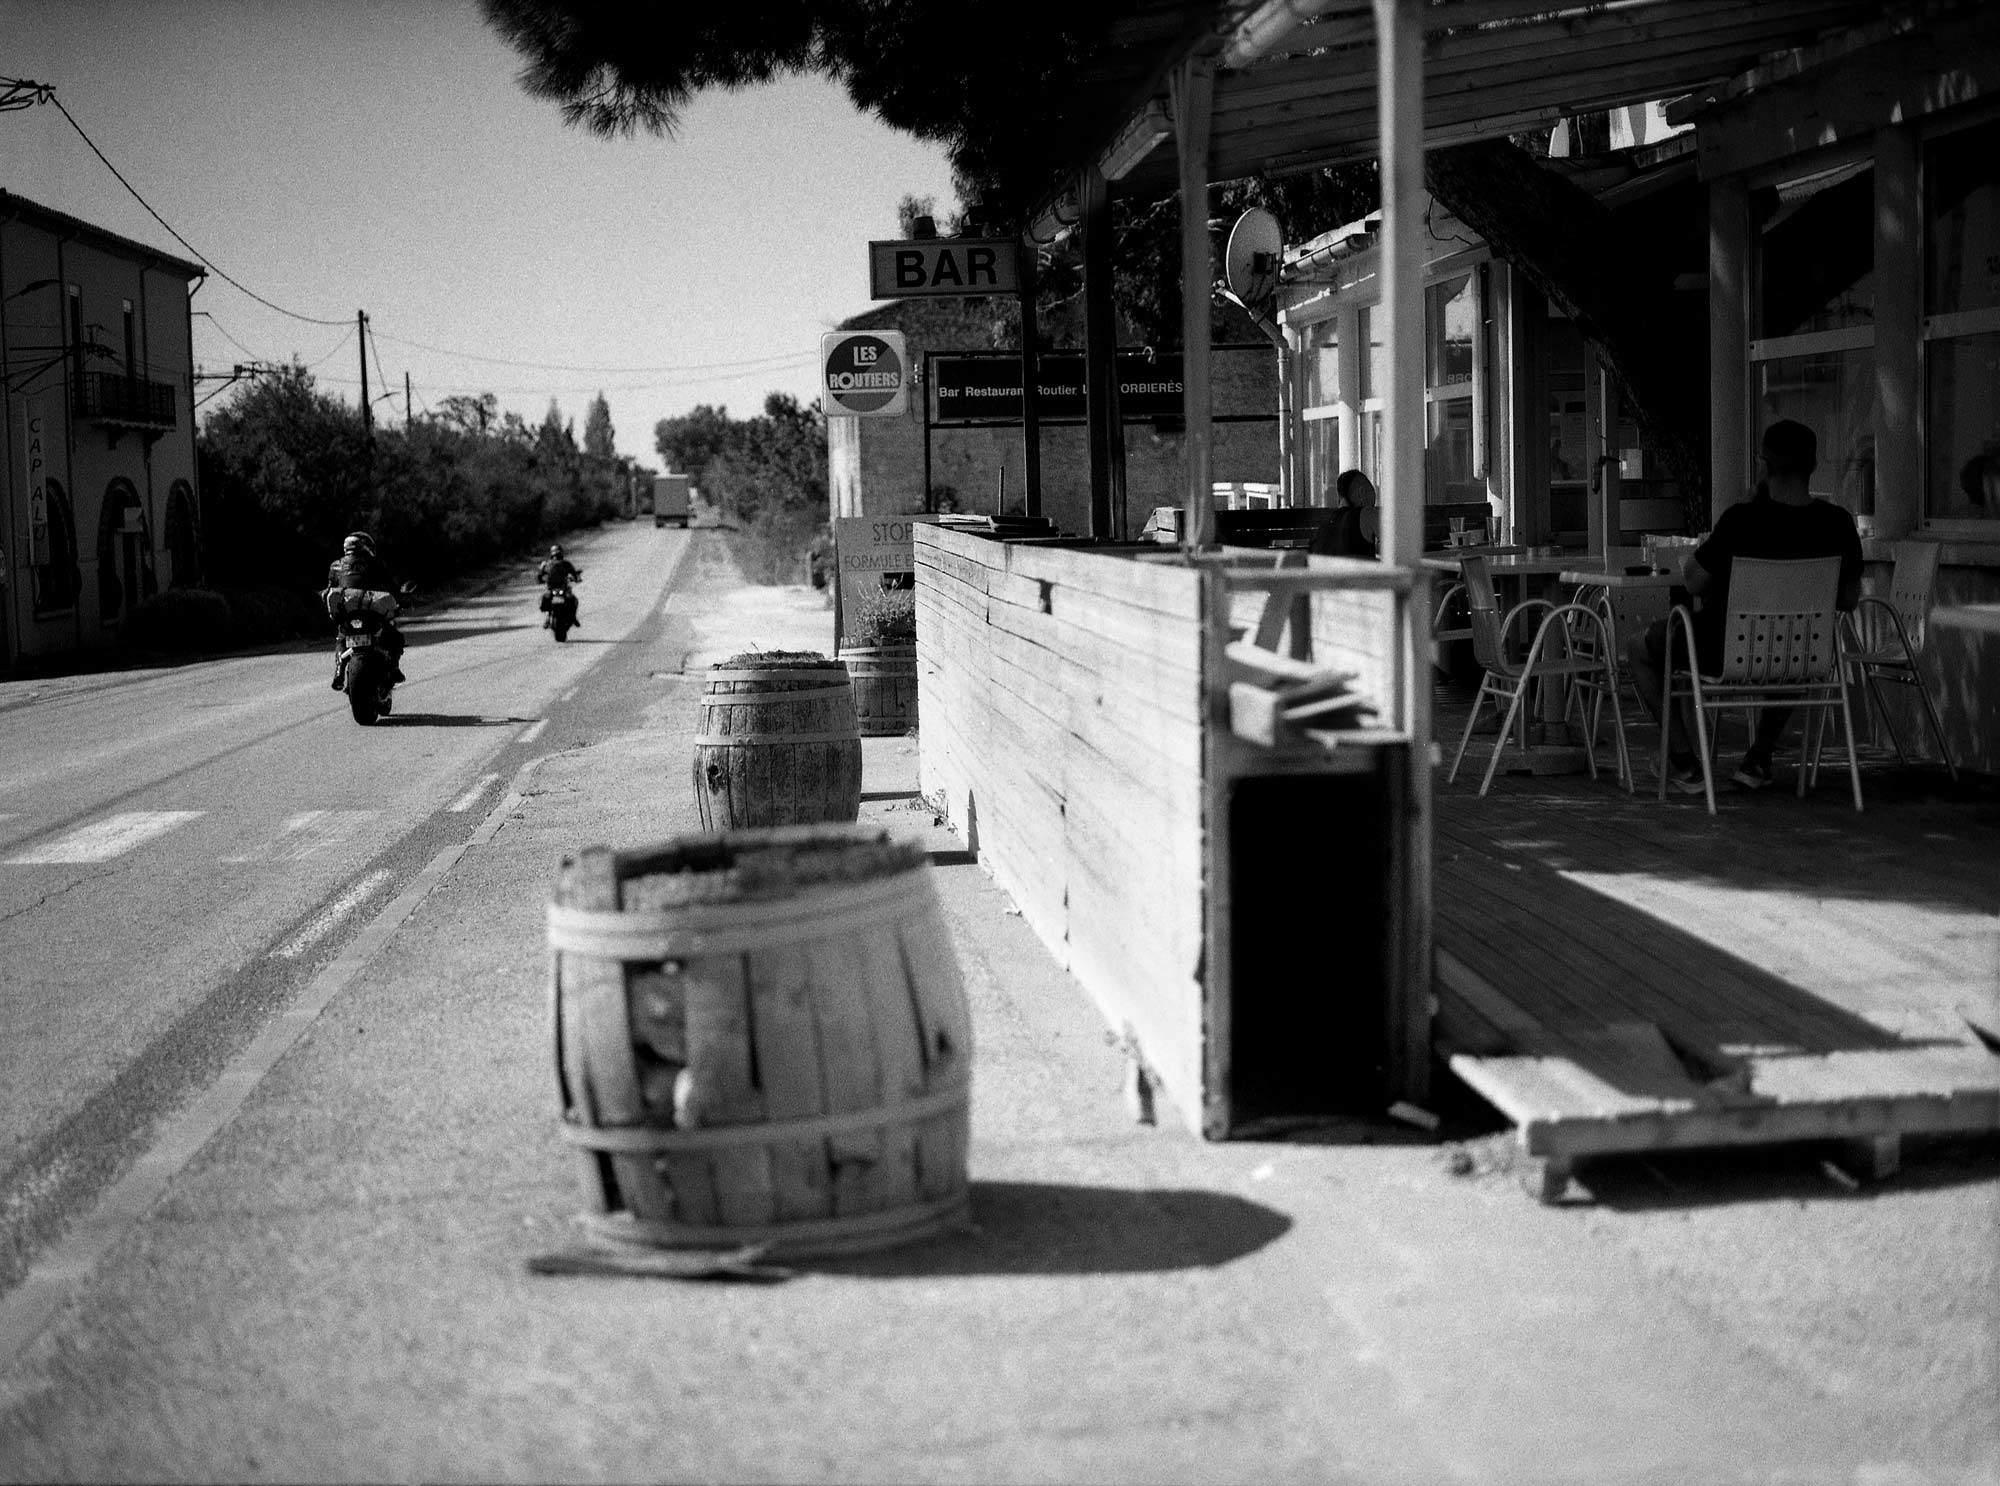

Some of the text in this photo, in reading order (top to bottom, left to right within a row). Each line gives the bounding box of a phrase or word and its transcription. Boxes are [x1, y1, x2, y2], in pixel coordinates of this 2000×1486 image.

[896, 247, 997, 288] BAR
[853, 345, 877, 367] LES
[829, 371, 899, 390] ROUTIERS
[939, 386, 960, 398] Bar
[965, 385, 1024, 398] Restauran
[1120, 379, 1184, 394] ORBIERÈS
[30, 418, 42, 473] CAP
[872, 522, 914, 542] STOP
[844, 554, 902, 569] FORMULE
